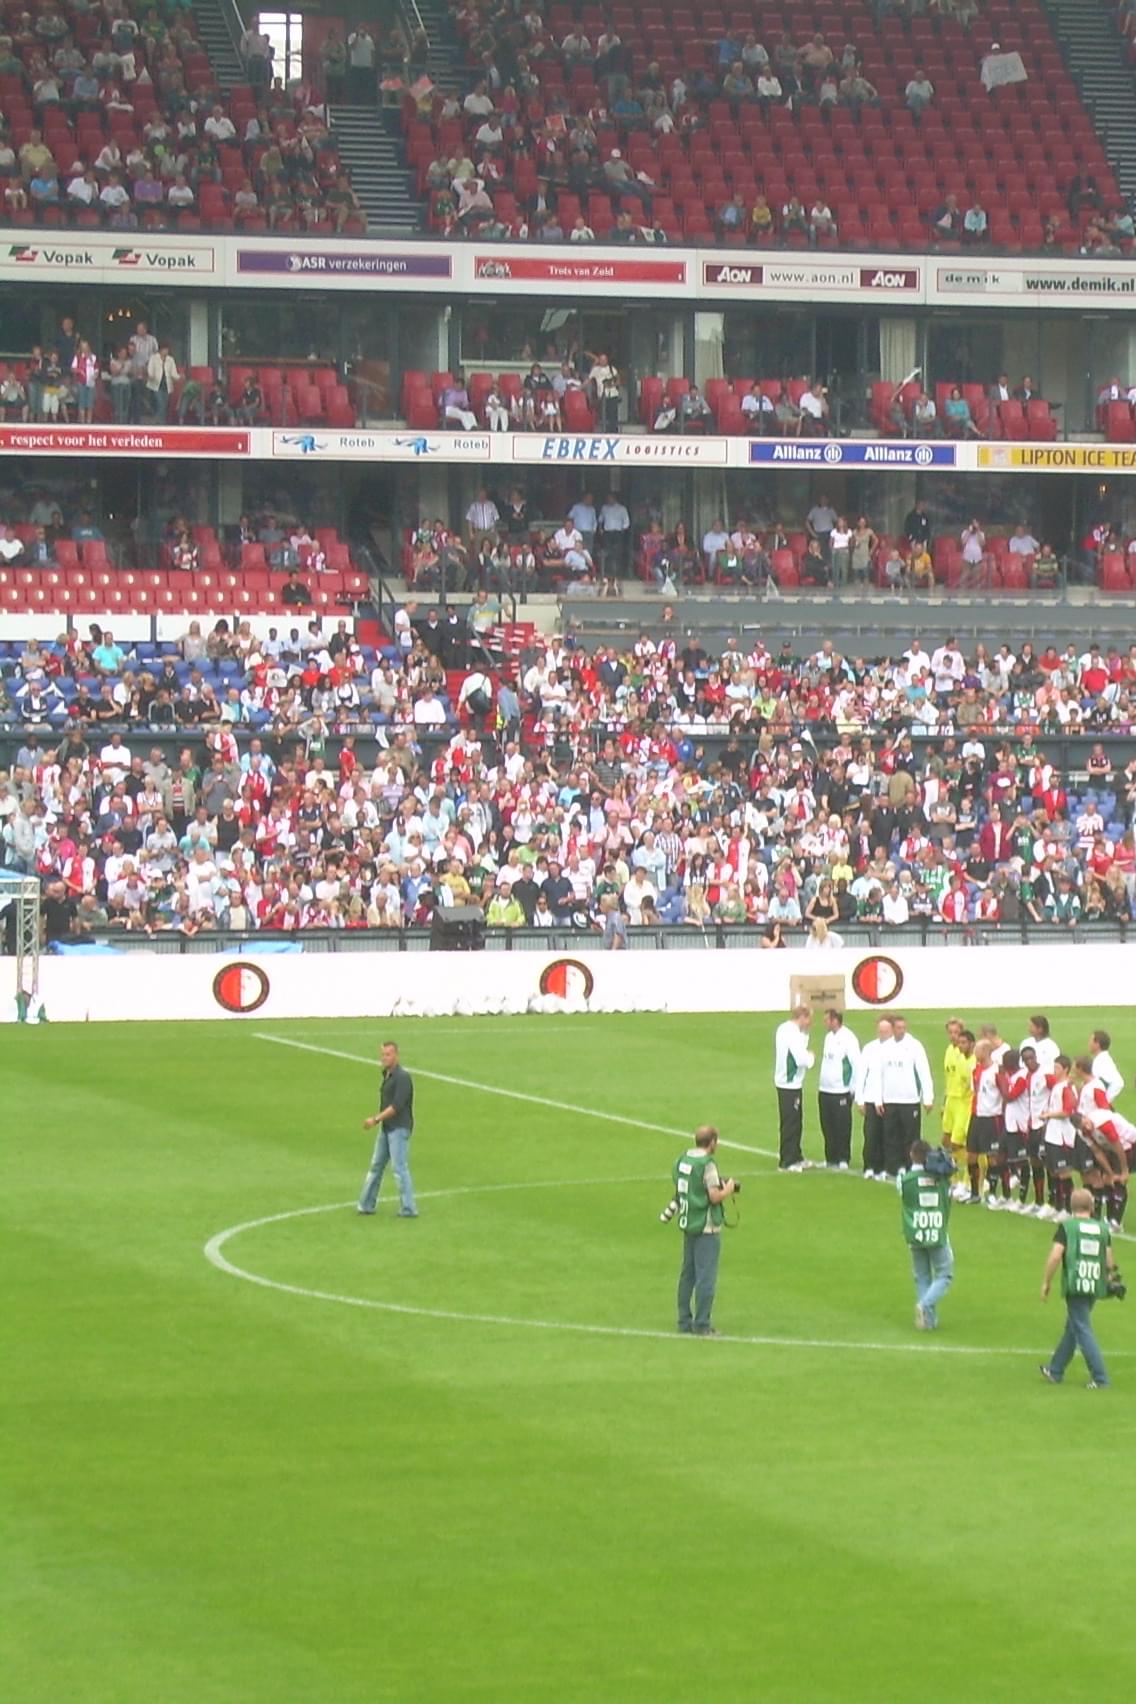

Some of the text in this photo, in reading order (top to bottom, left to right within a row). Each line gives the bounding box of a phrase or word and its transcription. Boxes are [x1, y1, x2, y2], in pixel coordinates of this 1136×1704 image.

[44, 251, 93, 267] Vopak
[146, 253, 195, 269] Vopak
[302, 258, 407, 274] ASR verzekeringen
[770, 271, 854, 285] www.aon.nl
[1026, 277, 1135, 293] www.demik.nl
[10, 434, 163, 449] respect voor het verleden
[339, 437, 375, 448] Roteb
[454, 439, 489, 450] Roteb
[542, 438, 700, 460] EBREX LOGISTICS
[773, 446, 822, 460] Allianz
[864, 447, 913, 462] Allianz
[1021, 449, 1076, 465] LIPTON
[1083, 450, 1105, 466] ICE
[912, 1211, 943, 1229] FOTO
[915, 1229, 939, 1243] 415
[1077, 1260, 1101, 1280] OTO
